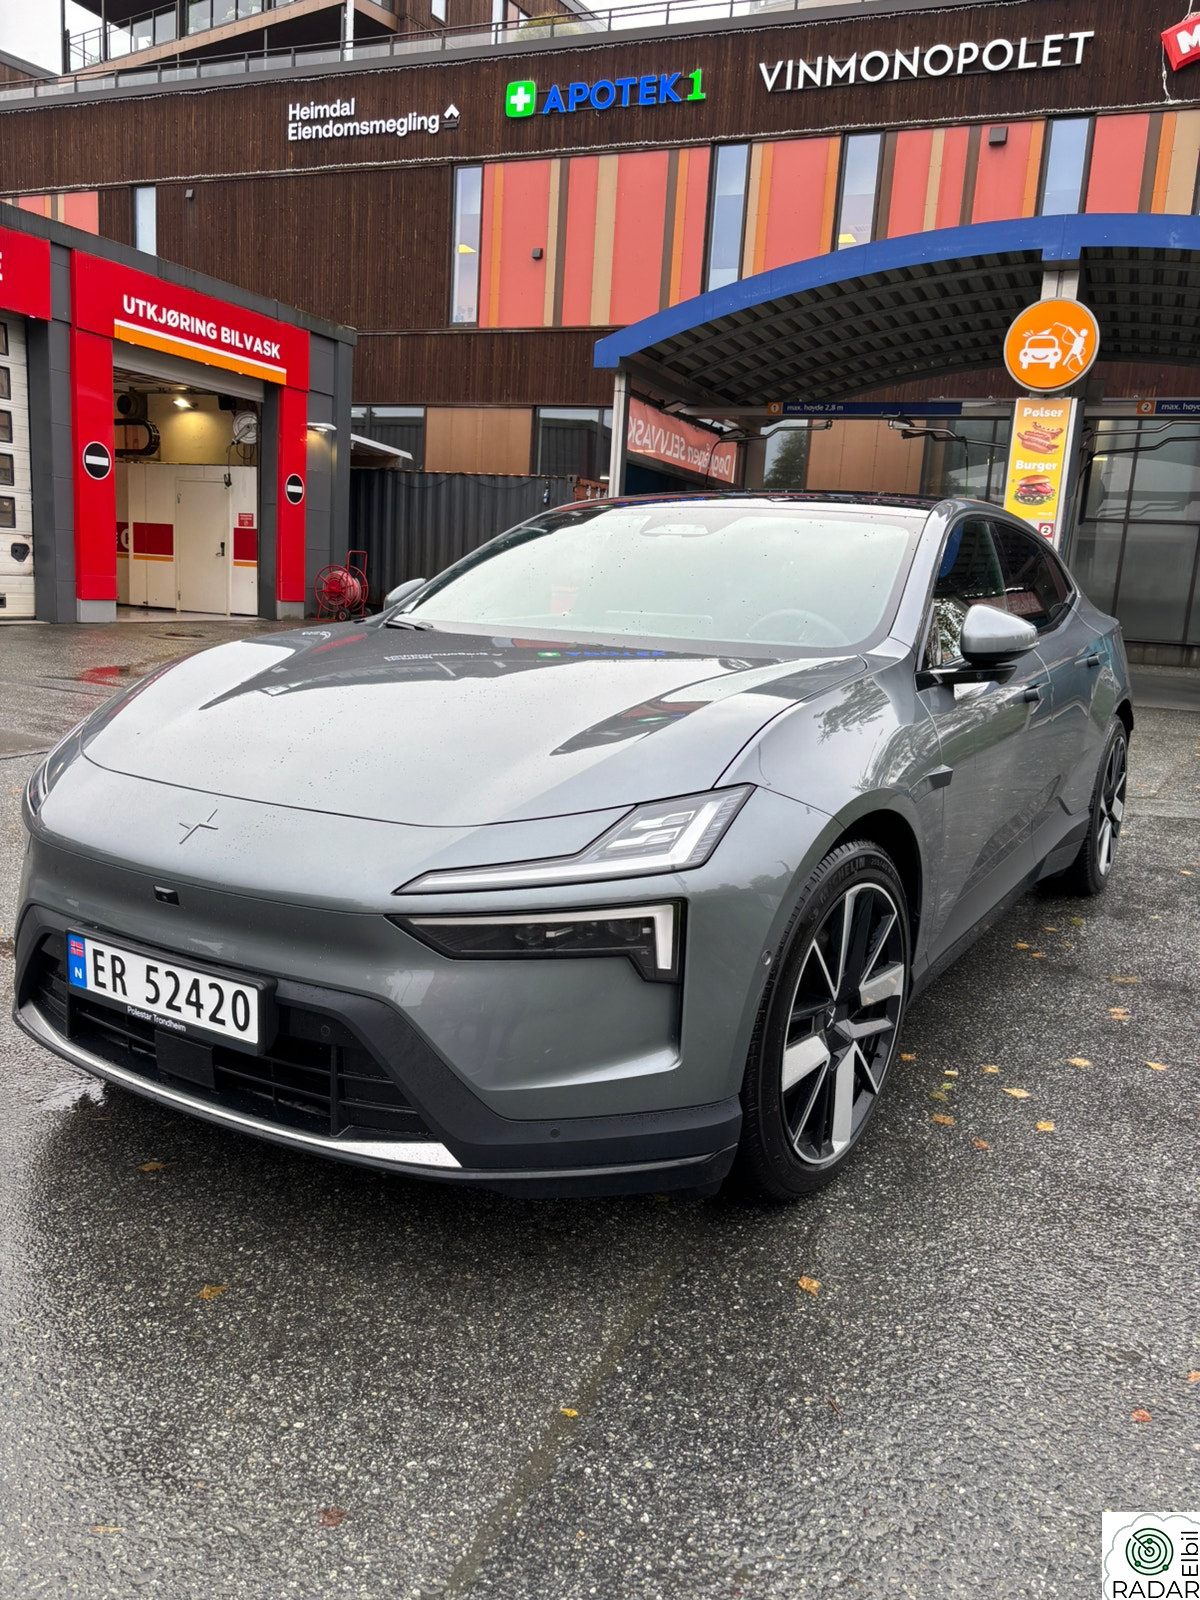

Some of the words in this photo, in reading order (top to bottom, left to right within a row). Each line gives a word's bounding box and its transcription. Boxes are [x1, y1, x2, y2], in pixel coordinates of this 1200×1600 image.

[758, 30, 1095, 92] VINMONOPOLET
[288, 97, 356, 121] Heimdal
[287, 112, 440, 141] Eiendomsmegling
[122, 294, 218, 340] UTKJØRING
[220, 326, 281, 360] BILVASK
[1023, 407, 1064, 417] Pølser
[1015, 460, 1058, 472] Burger
[74, 966, 83, 980] N
[92, 948, 128, 997] ER
[145, 964, 250, 1032] 52420
[127, 1005, 152, 1021] Polestar
[152, 1013, 186, 1032] Trondheim
